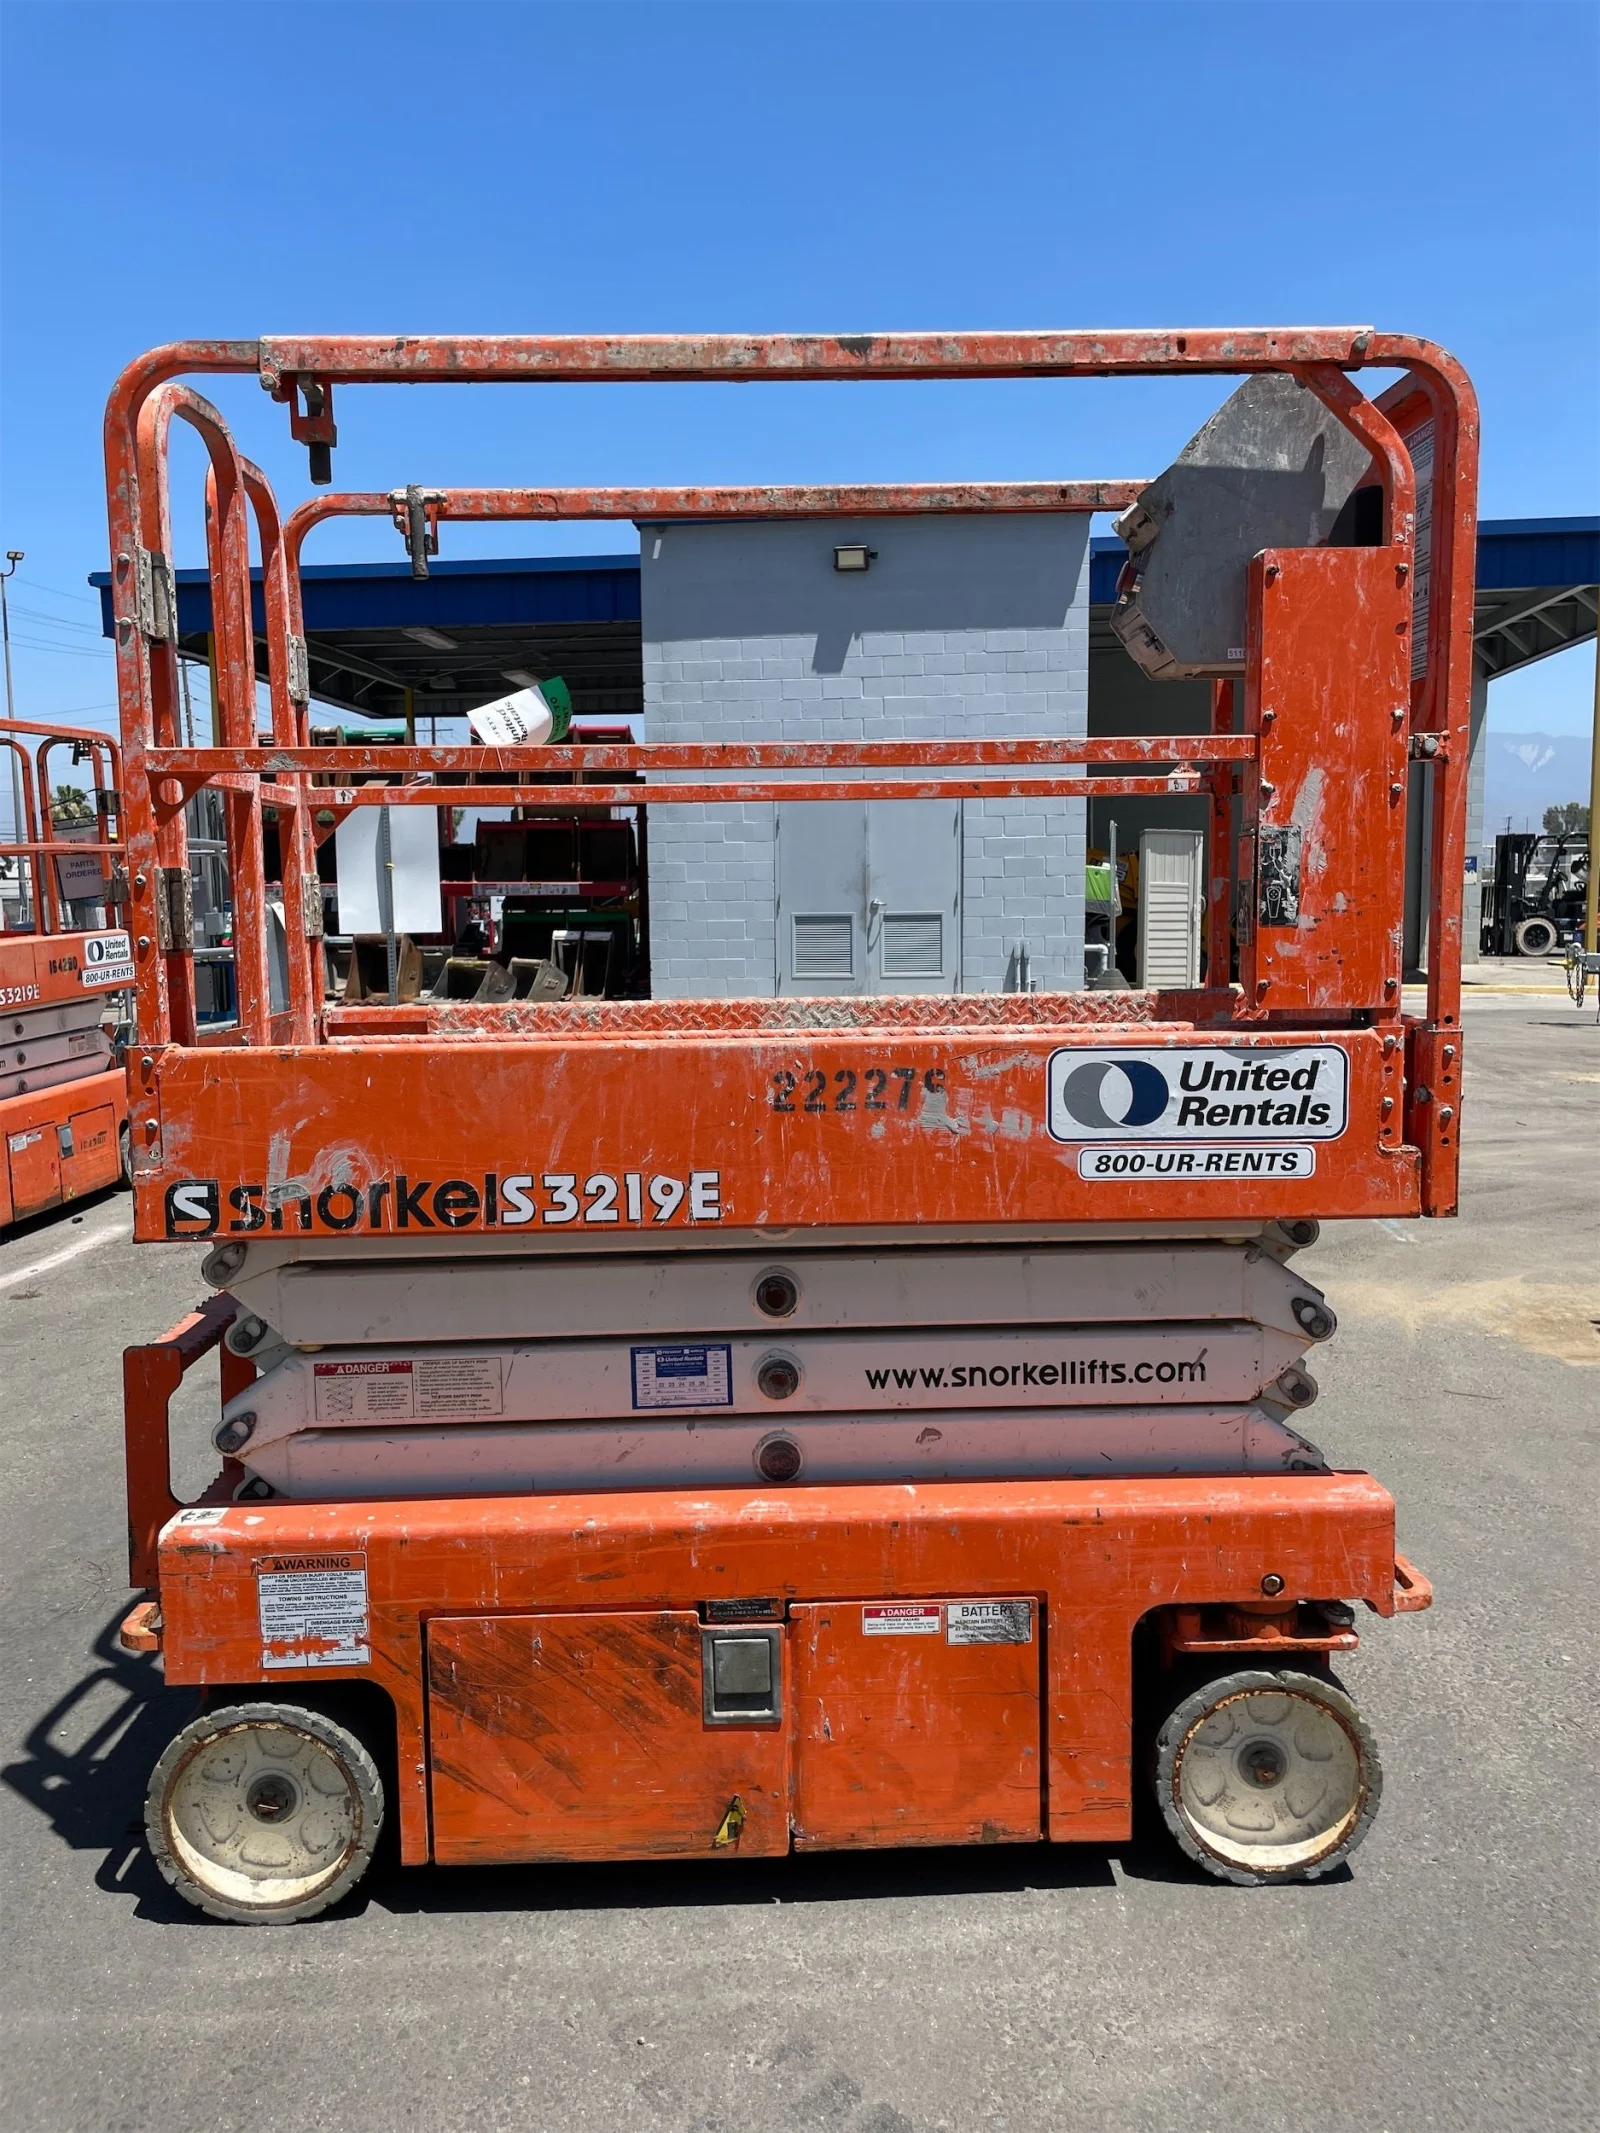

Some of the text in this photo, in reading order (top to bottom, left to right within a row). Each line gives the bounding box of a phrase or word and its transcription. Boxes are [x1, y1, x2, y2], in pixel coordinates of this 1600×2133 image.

[505, 701, 528, 742] Rentals
[70, 859, 95, 868] PARTS
[65, 868, 102, 879] ORDERED
[105, 937, 126, 950] United
[105, 948, 128, 960] Rentals
[85, 966, 134, 983] 800-UR-RENTS
[1179, 1059, 1320, 1092] United
[1176, 1095, 1331, 1127] Rentals
[1094, 1151, 1299, 1173] 800-UR-RENTS
[229, 1173, 497, 1233] snorkel
[500, 1171, 721, 1225] S3219E
[346, 1363, 390, 1374] DANGER
[865, 1359, 1206, 1390] www.snorkellifts.com
[284, 1557, 351, 1569] WARNING
[887, 1608, 925, 1616] DANGER
[961, 1604, 1014, 1617] BATTERY
